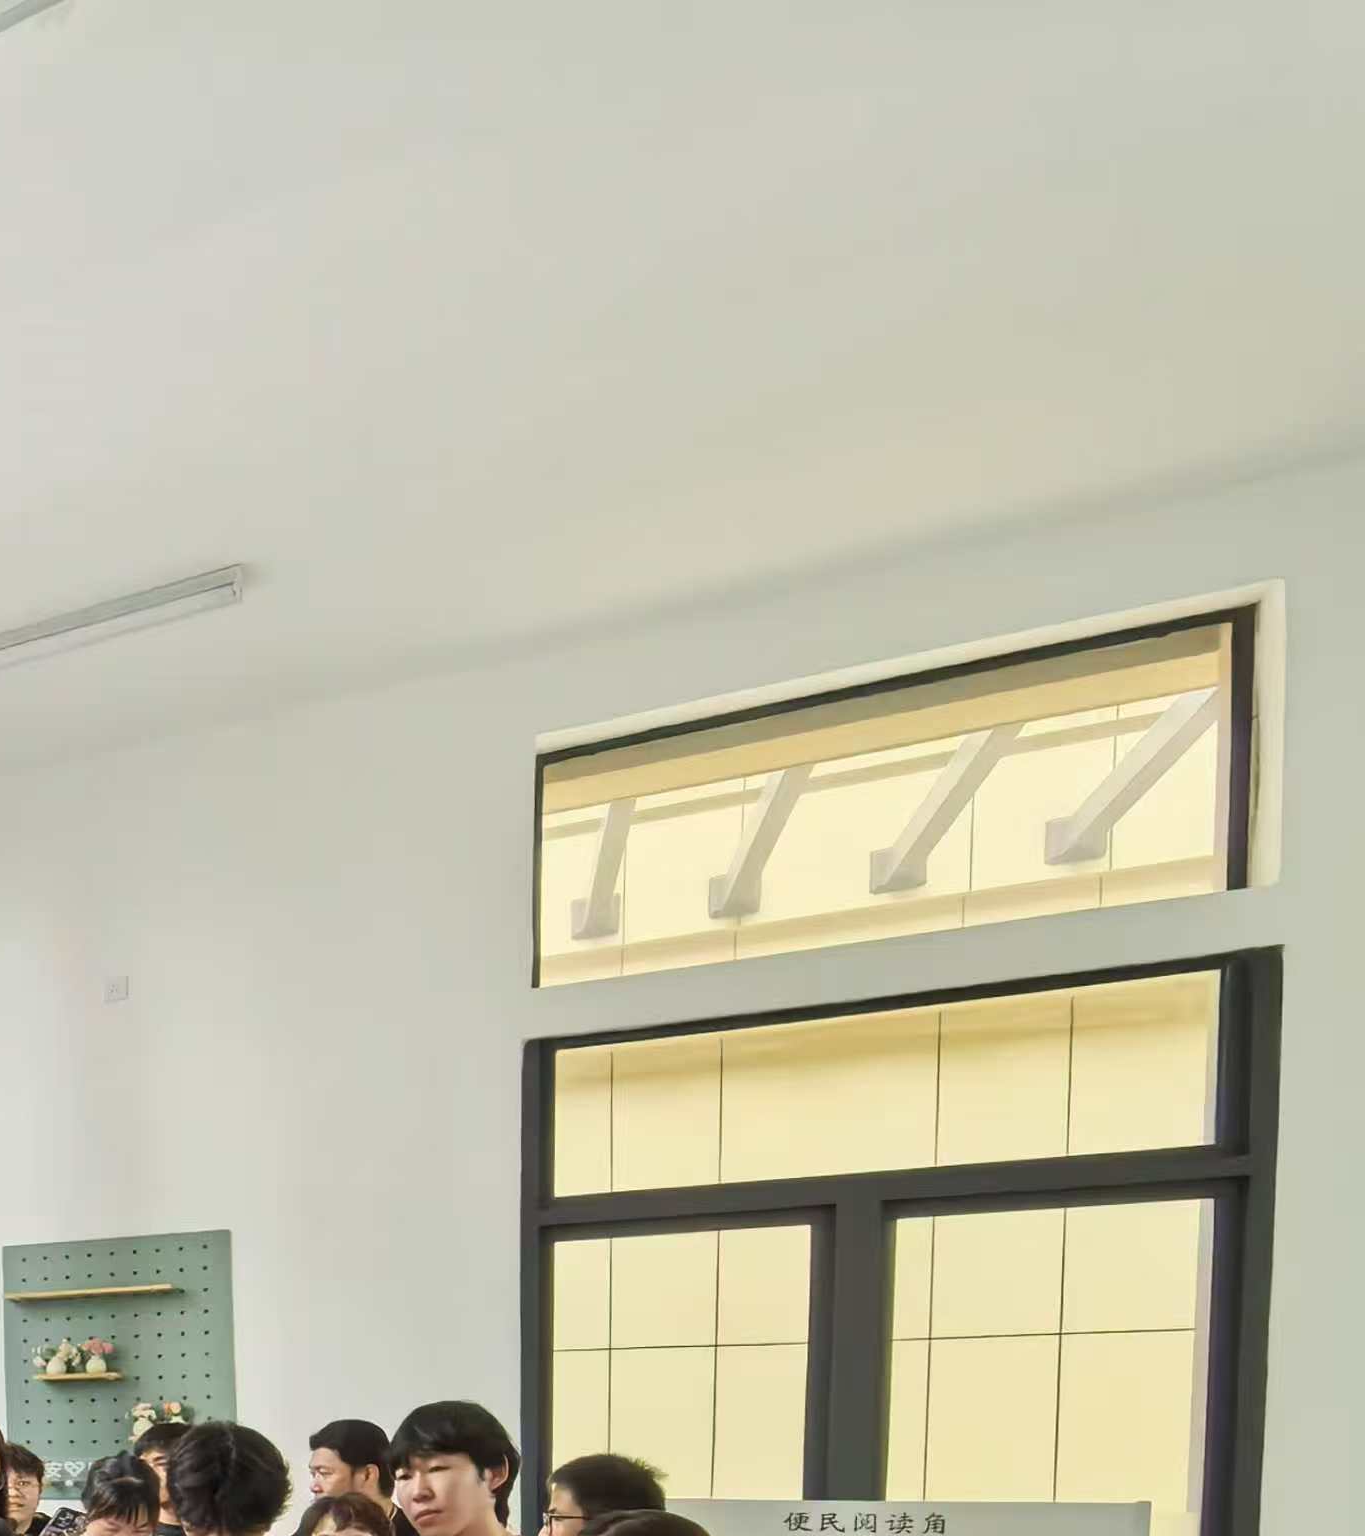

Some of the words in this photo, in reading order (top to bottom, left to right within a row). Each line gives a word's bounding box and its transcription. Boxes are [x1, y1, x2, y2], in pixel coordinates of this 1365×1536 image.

[782, 1510, 948, 1535] 便民阅读角
